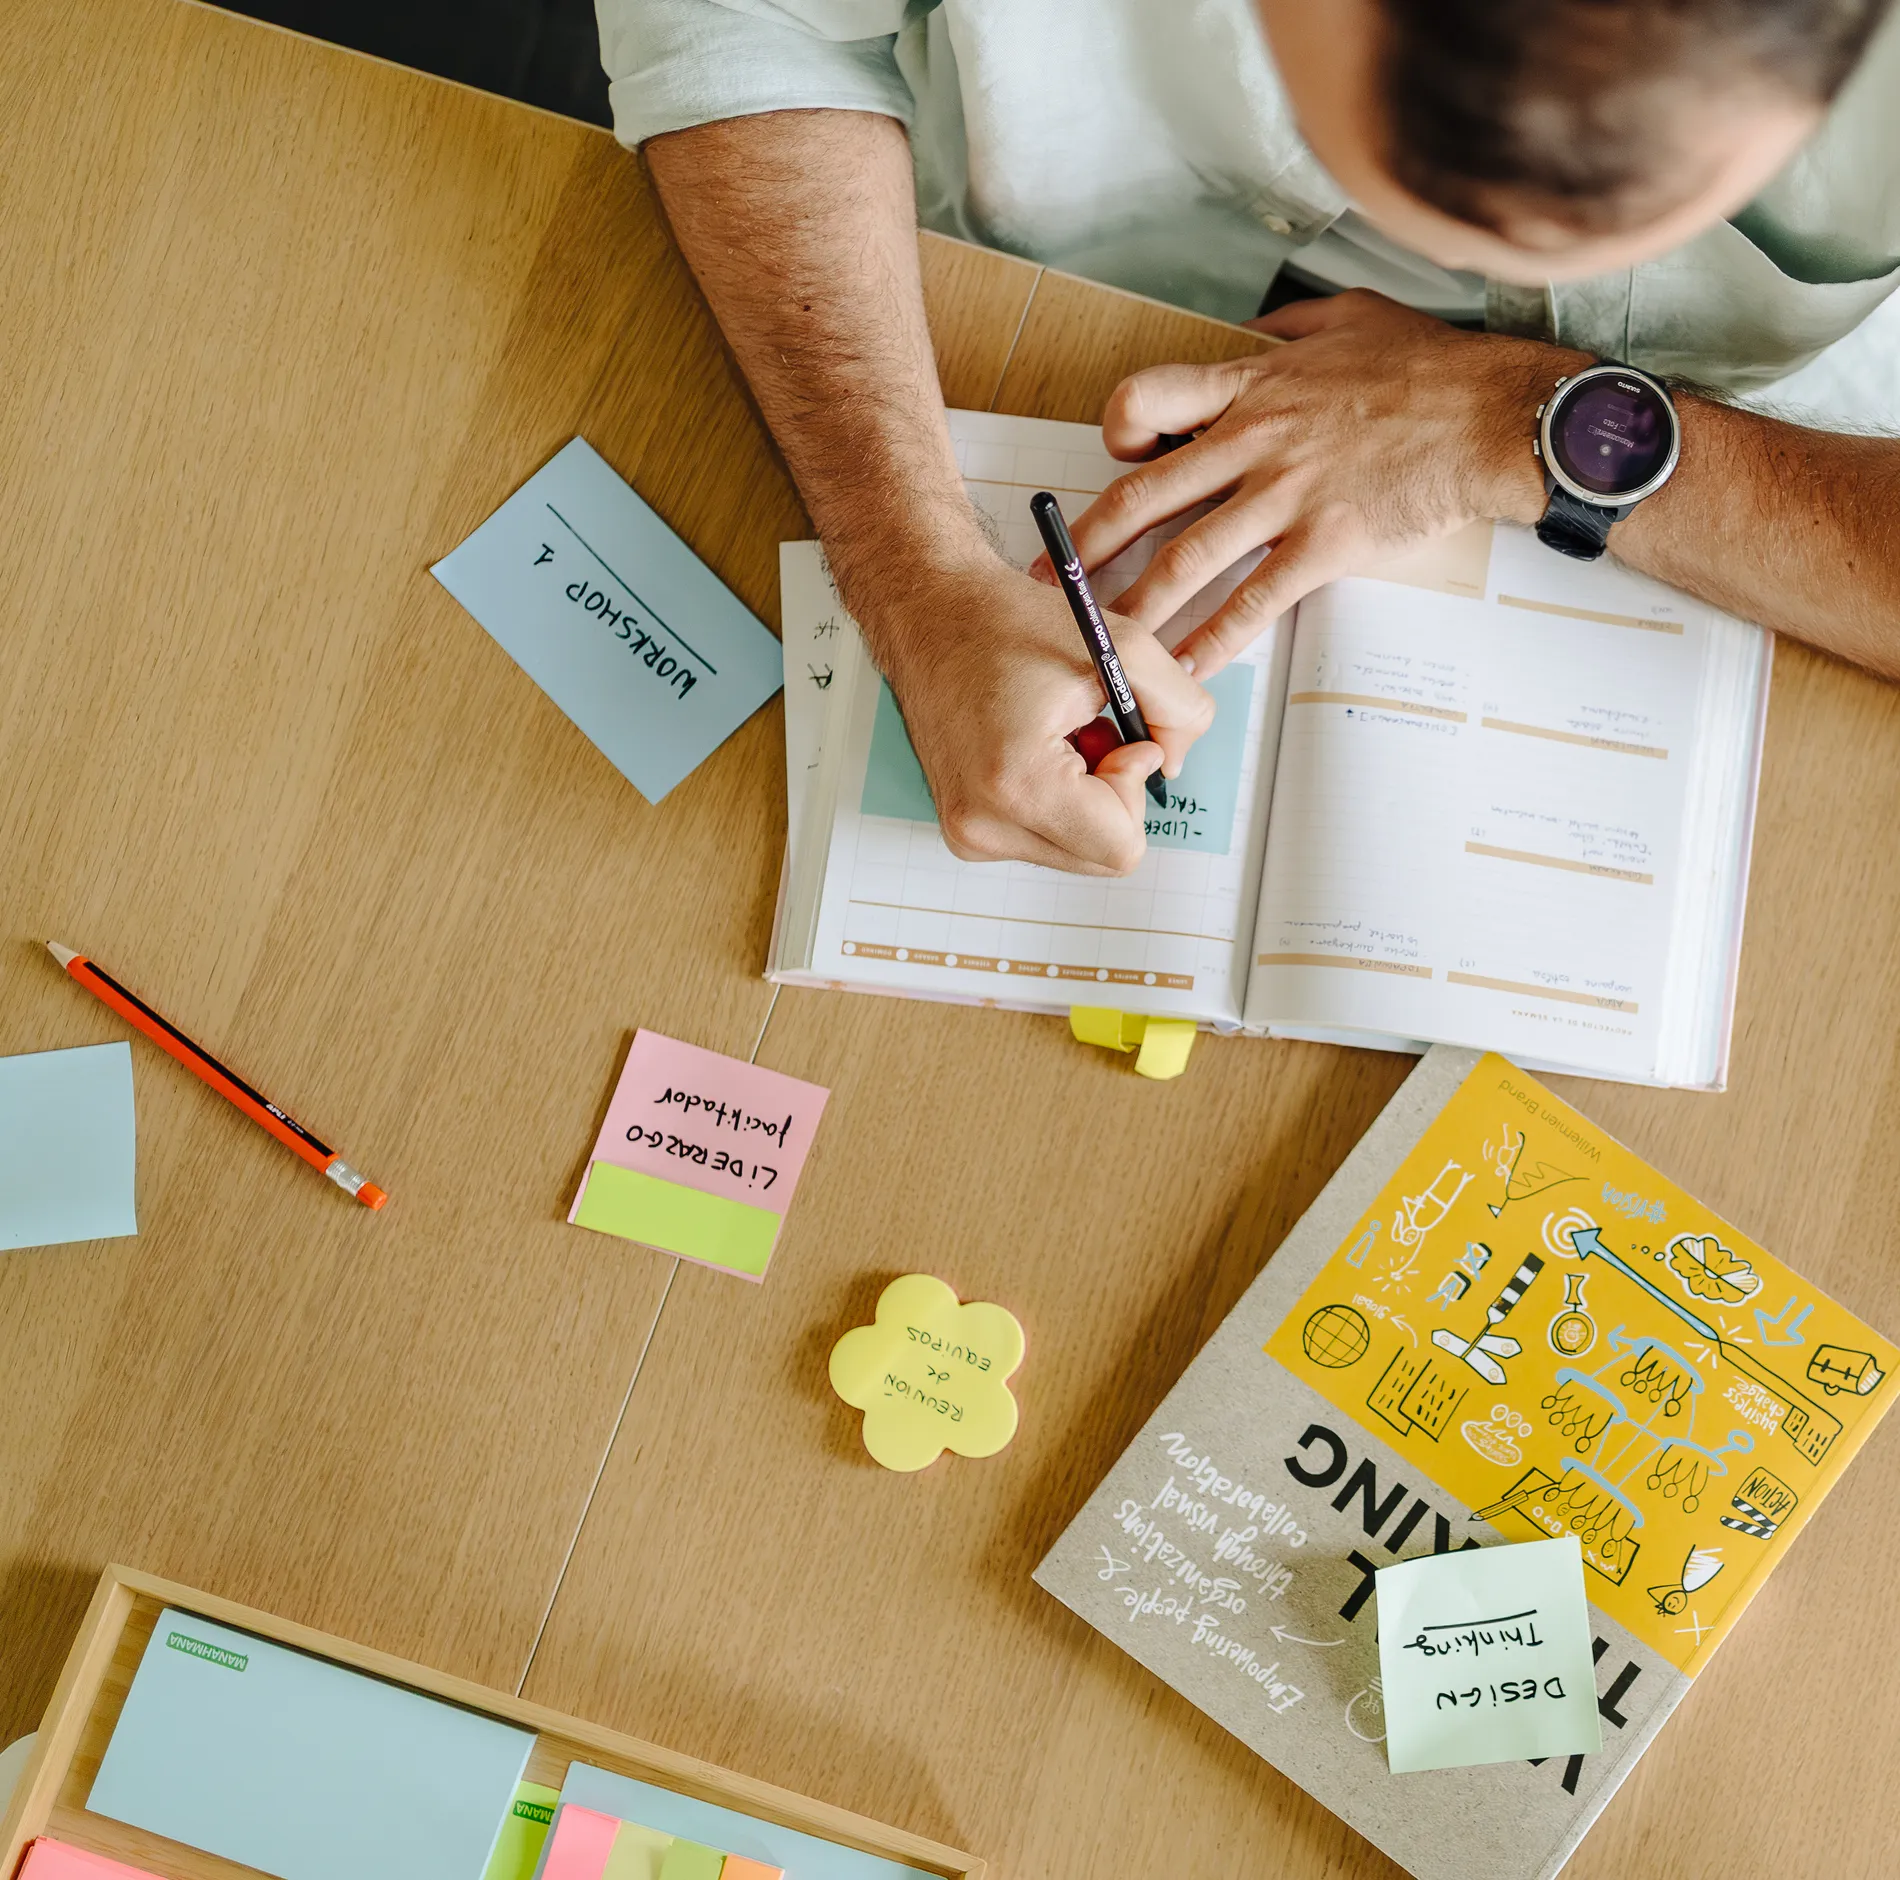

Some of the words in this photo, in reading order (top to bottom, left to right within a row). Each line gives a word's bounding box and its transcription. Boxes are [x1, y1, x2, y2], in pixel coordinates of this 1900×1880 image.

[1077, 580, 1088, 596] fine
[1082, 592, 1094, 607] pen
[1087, 606, 1100, 626] colour
[565, 581, 698, 700] WORKSHOP
[1094, 625, 1111, 651] 1200
[1108, 658, 1130, 703] edding
[653, 1087, 793, 1148] facilitador
[1498, 1079, 1540, 1115] Brand
[1541, 1109, 1601, 1164] Willemien
[1351, 1293, 1391, 1320] global
[1722, 1387, 1778, 1436] business
[1732, 1375, 1785, 1417] change
[1150, 1475, 1218, 1535] visual
[1160, 1431, 1307, 1548] collaboration
[1741, 1476, 1791, 1516] ACTION
[1094, 1545, 1131, 1581] &
[1113, 1499, 1247, 1615] organizations
[1212, 1525, 1294, 1601] through
[1114, 1586, 1194, 1625] people
[168, 1633, 247, 1670] MANAHMANA
[1402, 1621, 1544, 1657] Thinking
[1190, 1613, 1305, 1715] Empowering
